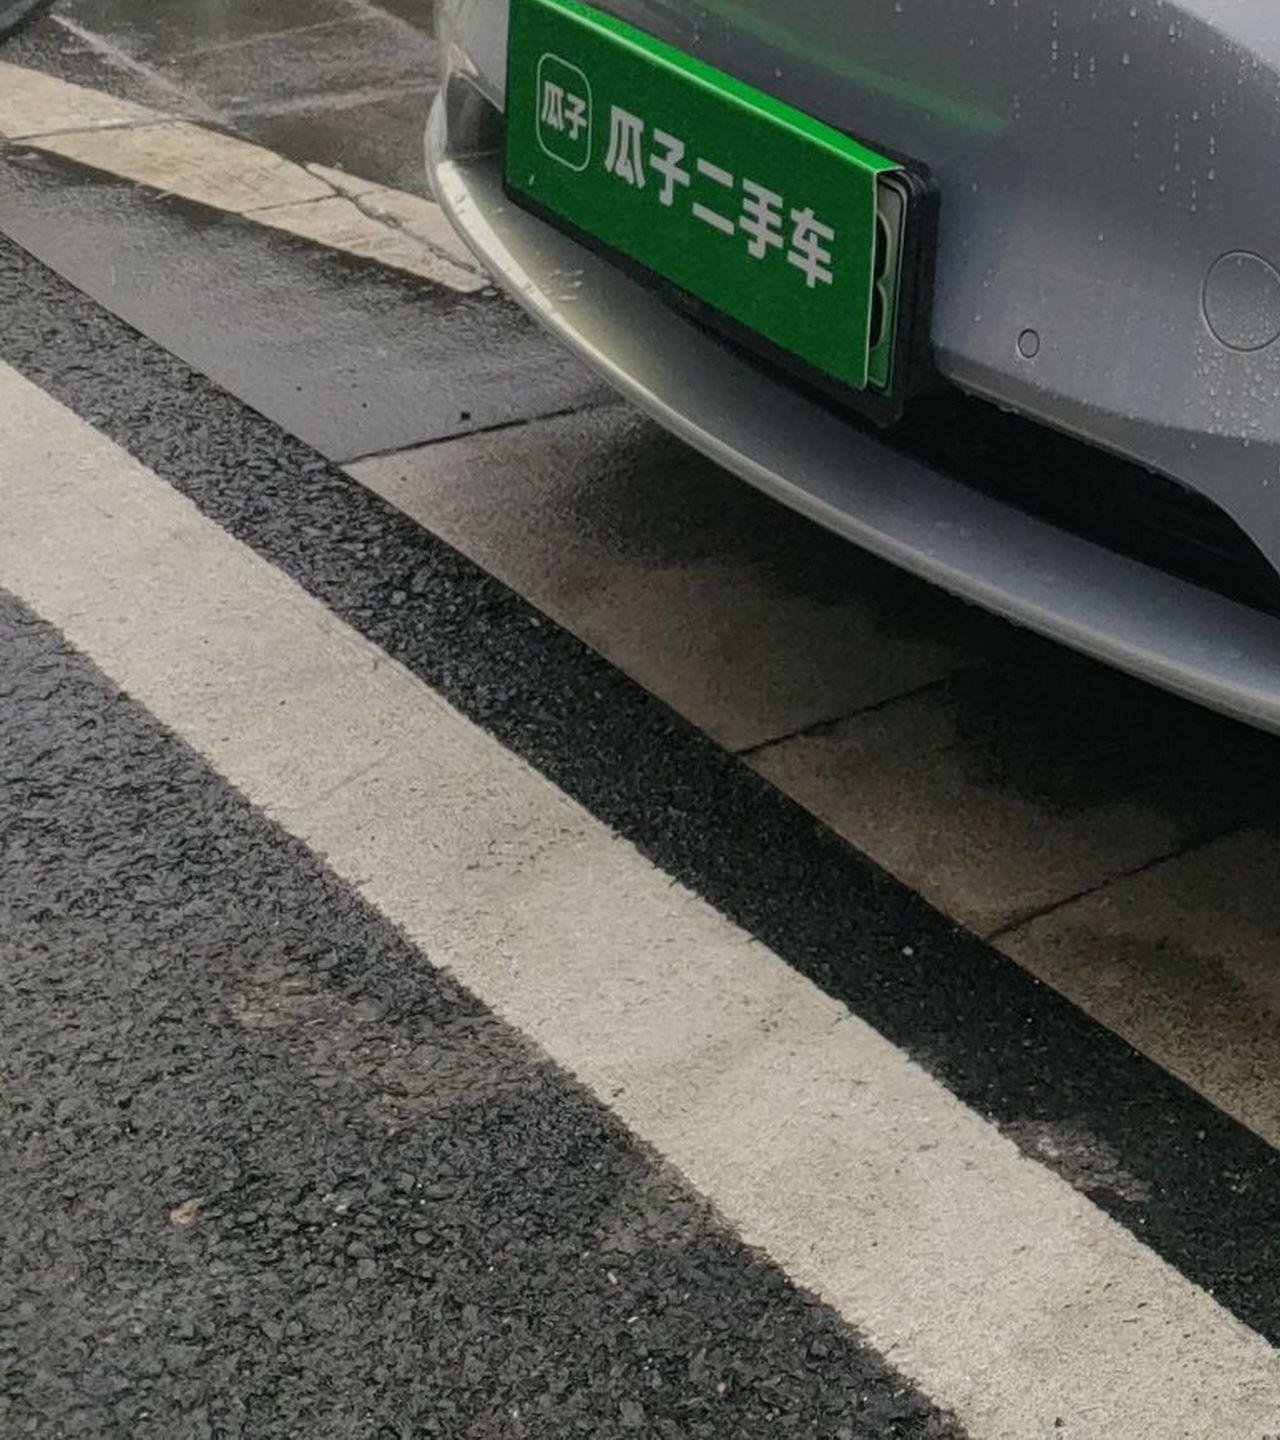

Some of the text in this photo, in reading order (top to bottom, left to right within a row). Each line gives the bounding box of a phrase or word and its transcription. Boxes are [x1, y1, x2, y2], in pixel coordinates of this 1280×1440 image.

[541, 80, 588, 141] 瓜子
[604, 104, 835, 289] 瓜子二手车
